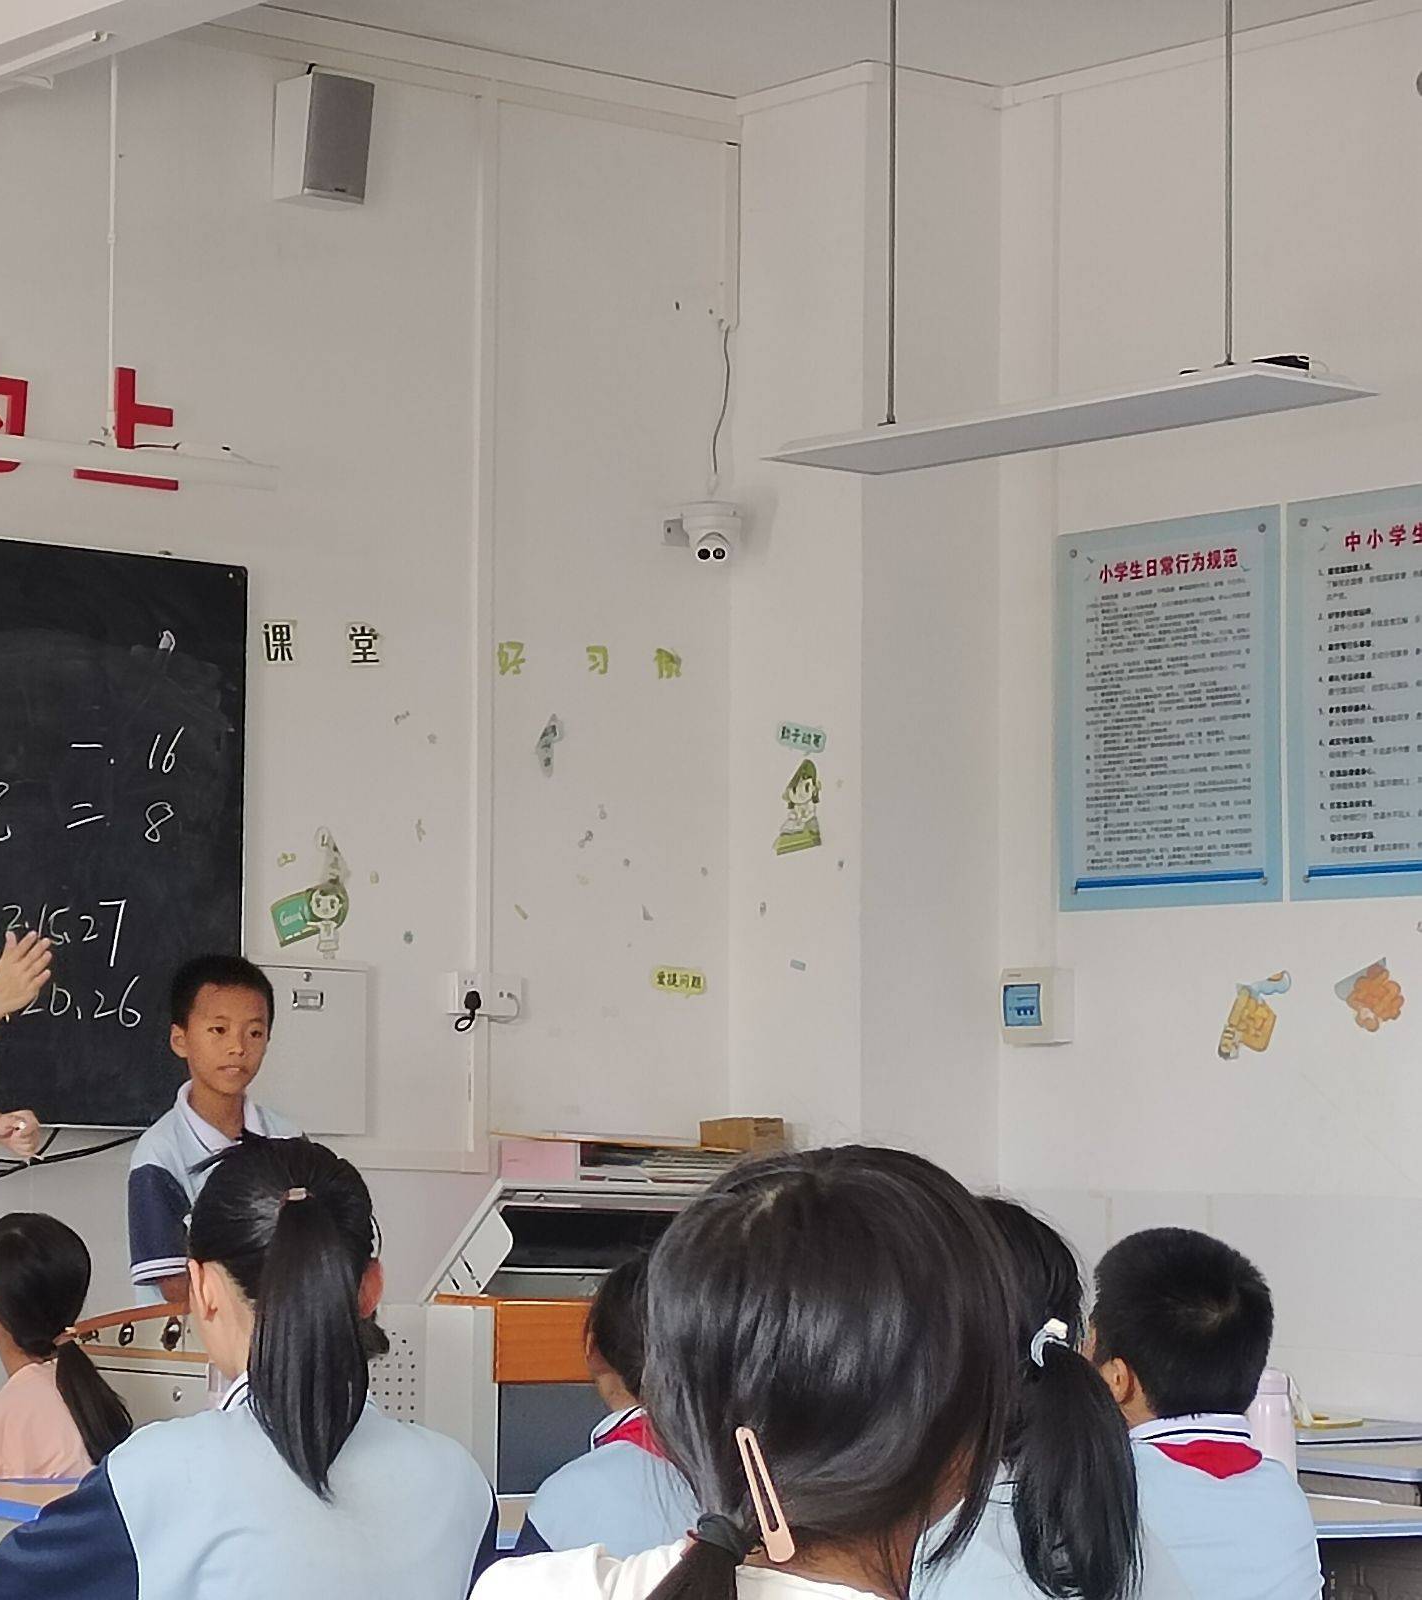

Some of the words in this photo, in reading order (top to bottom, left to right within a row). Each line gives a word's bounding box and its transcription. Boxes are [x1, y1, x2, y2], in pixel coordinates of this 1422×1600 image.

[1099, 548, 1239, 584] 小学生日常行为规范
[262, 622, 379, 664] 课堂
[148, 726, 185, 774] 16
[144, 801, 175, 843] 8
